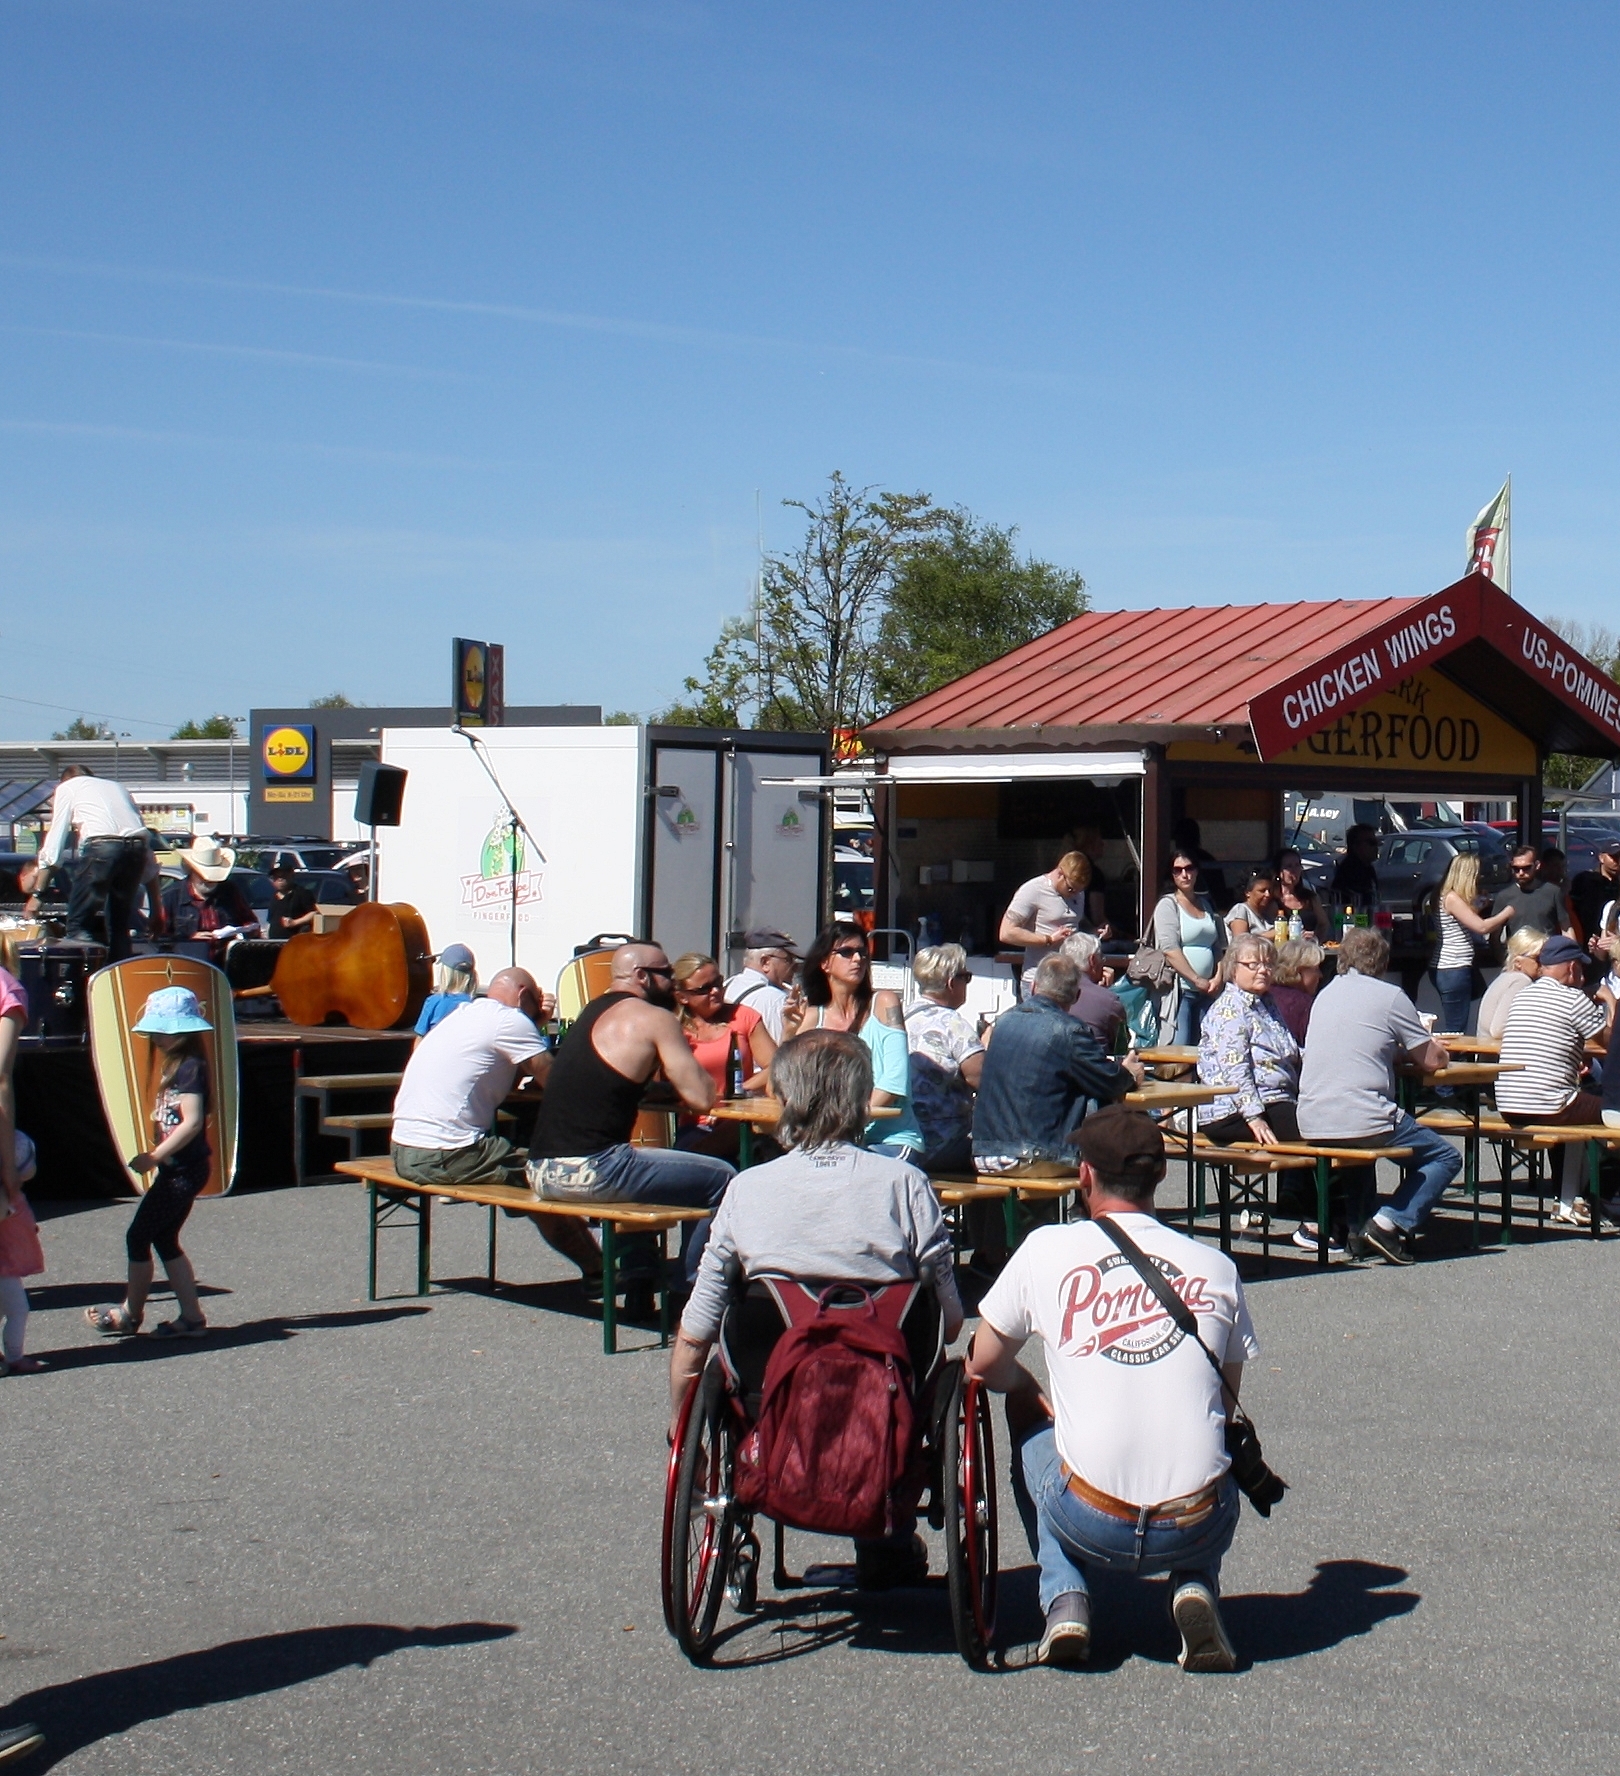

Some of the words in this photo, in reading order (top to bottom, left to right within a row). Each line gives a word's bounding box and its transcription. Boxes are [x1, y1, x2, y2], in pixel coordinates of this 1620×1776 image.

[1282, 648, 1382, 729] CHICKEN
[1385, 605, 1456, 668] WINGS
[1290, 710, 1481, 763] GERFOOD
[473, 911, 530, 922] FINGERFOD
[1106, 1255, 1130, 1268] SWA
[1110, 1348, 1151, 1363] CLASSIC
[1152, 1342, 1171, 1359] CAR
